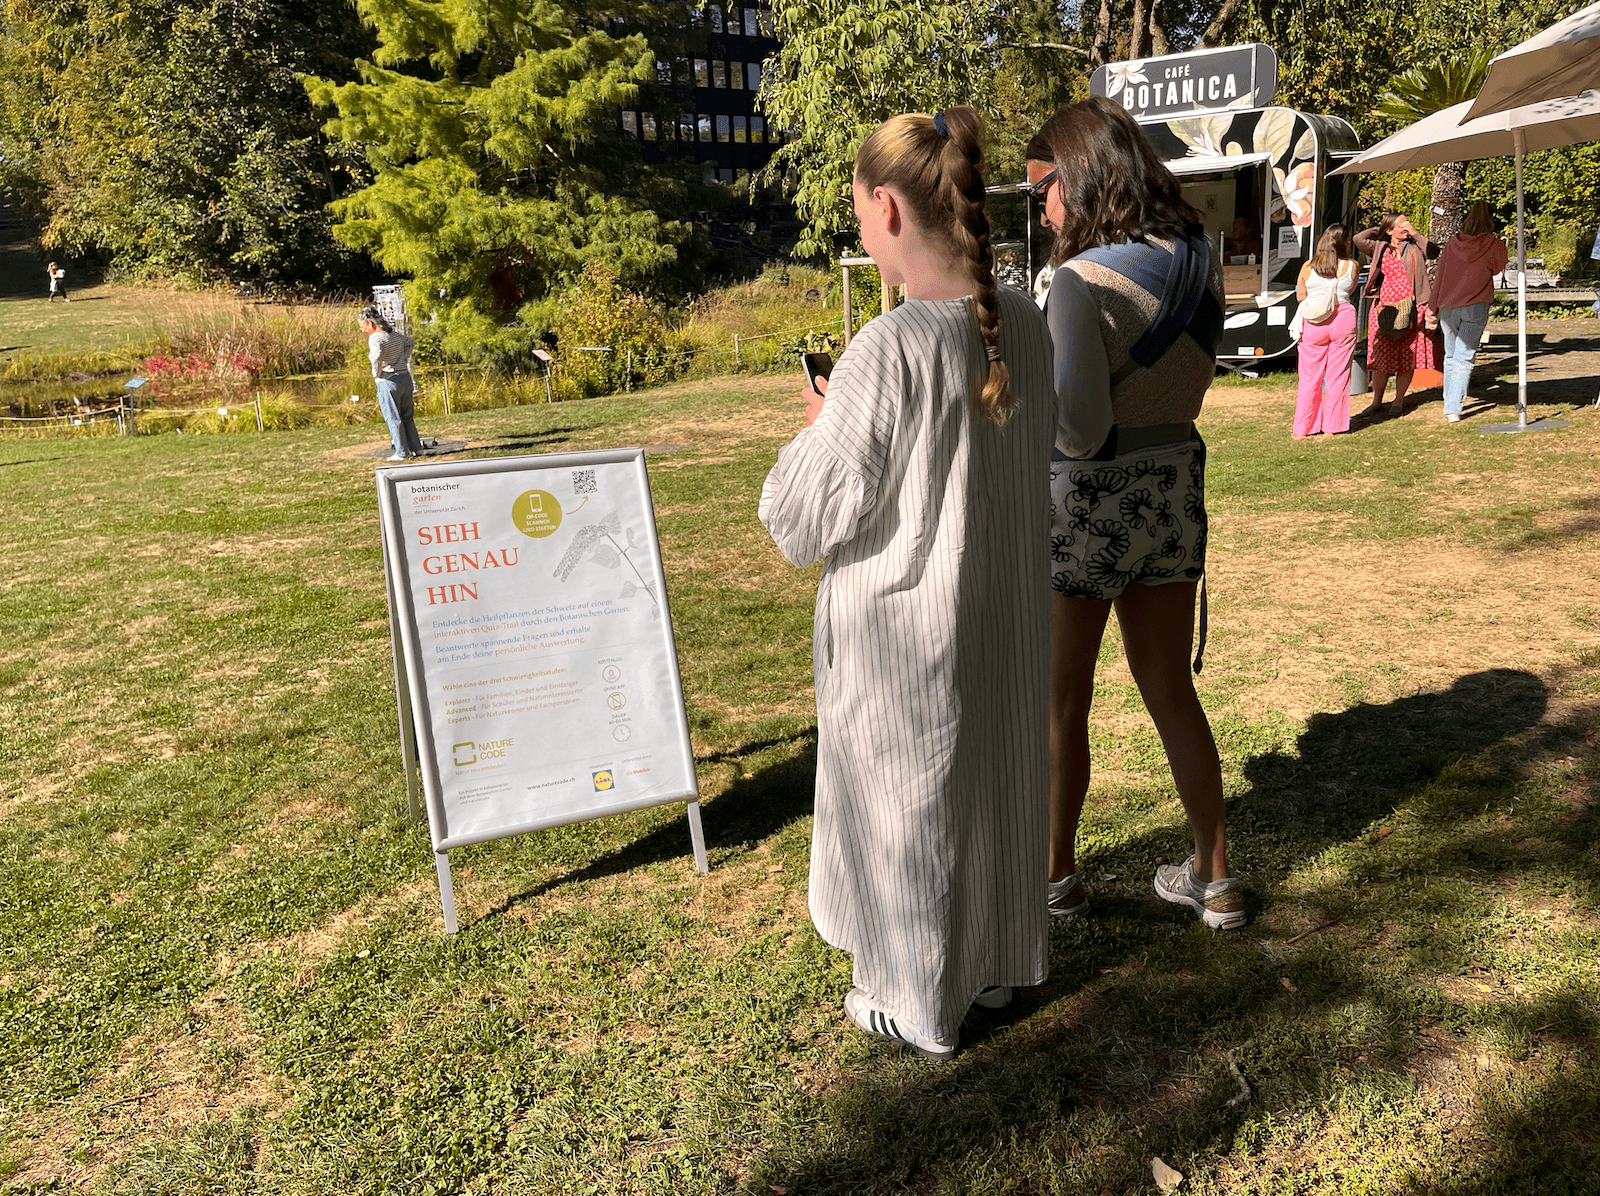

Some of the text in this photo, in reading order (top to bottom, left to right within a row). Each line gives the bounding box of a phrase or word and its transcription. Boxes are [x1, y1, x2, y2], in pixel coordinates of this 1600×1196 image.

[1165, 64, 1190, 79] CAFÉ
[1123, 74, 1236, 110] BOTANICA
[411, 483, 459, 493] botanischer
[413, 494, 441, 505] garten
[418, 522, 481, 546] SIEH
[422, 548, 519, 575] GENAU
[426, 582, 478, 606] HIN
[433, 618, 467, 628] Entdecke
[483, 610, 530, 621] Heilpflanzen
[546, 604, 575, 613] Schweiz
[434, 627, 479, 638] interaktiven
[481, 622, 518, 633] Quiz-Trail
[520, 618, 542, 626] durch
[559, 611, 602, 621] Botanischen
[436, 626, 591, 653] Beantworte spannende Fragen und erhalte
[451, 653, 470, 661] Ende
[495, 643, 537, 657] persönliche
[445, 698, 470, 706] Explorer
[549, 681, 578, 689] Einsteiger
[447, 704, 476, 714] Advanced
[448, 716, 470, 724] Experts
[479, 738, 514, 751] NATURE
[480, 749, 506, 760] CODE
[527, 777, 575, 790] www.naturecode.ch
